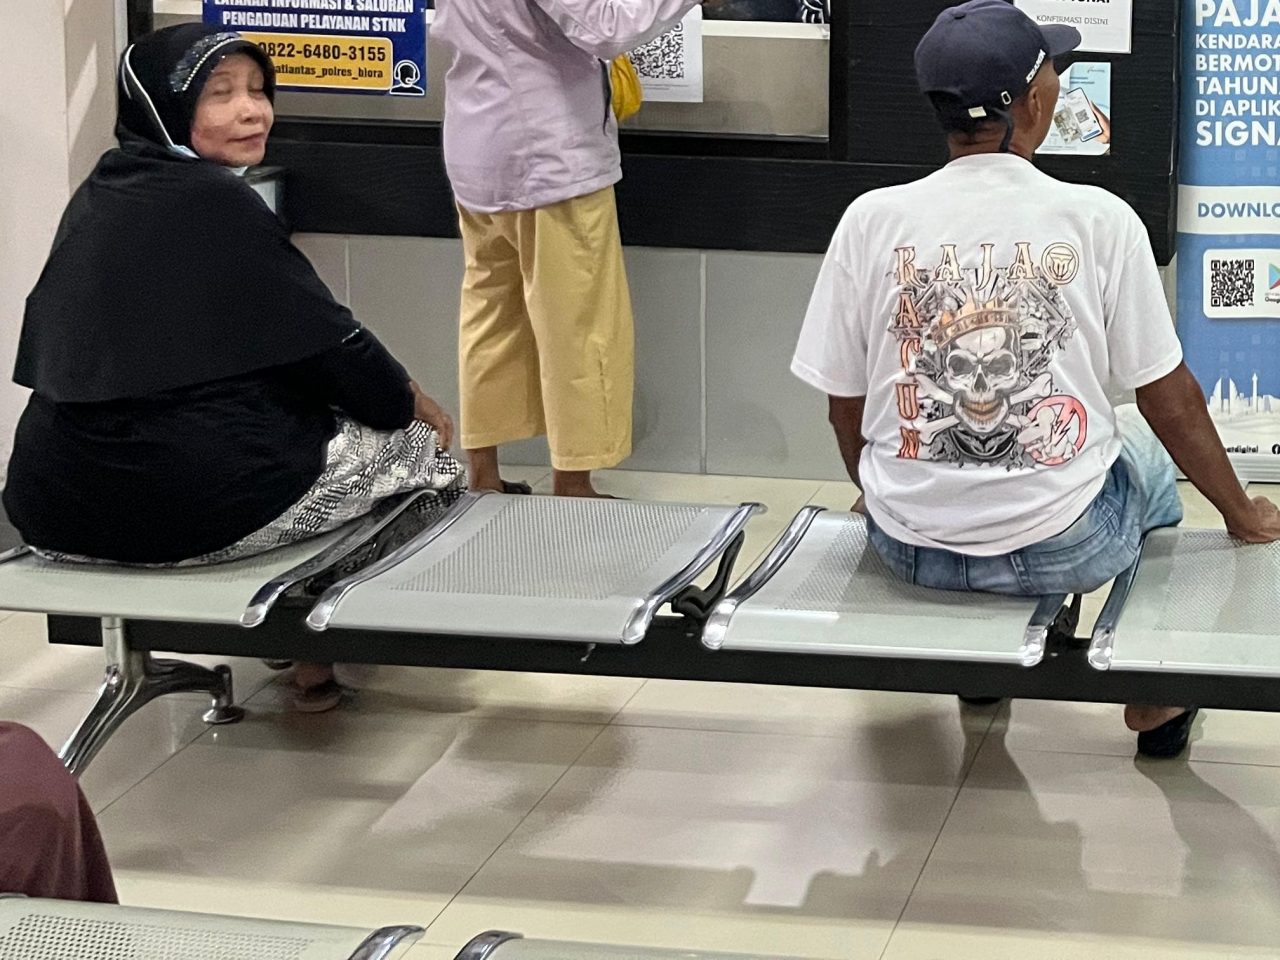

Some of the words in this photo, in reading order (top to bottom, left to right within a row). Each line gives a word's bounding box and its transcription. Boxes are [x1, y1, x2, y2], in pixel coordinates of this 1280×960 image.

[222, 11, 299, 28] PENGADUAN
[300, 14, 371, 31] PELAYANAN
[372, 17, 406, 33] STNK
[1036, 15, 1082, 24] KONFIRMASI
[1084, 17, 1108, 25] DISINI
[1195, 100, 1216, 117] DI
[894, 241, 1038, 290] RAJA
